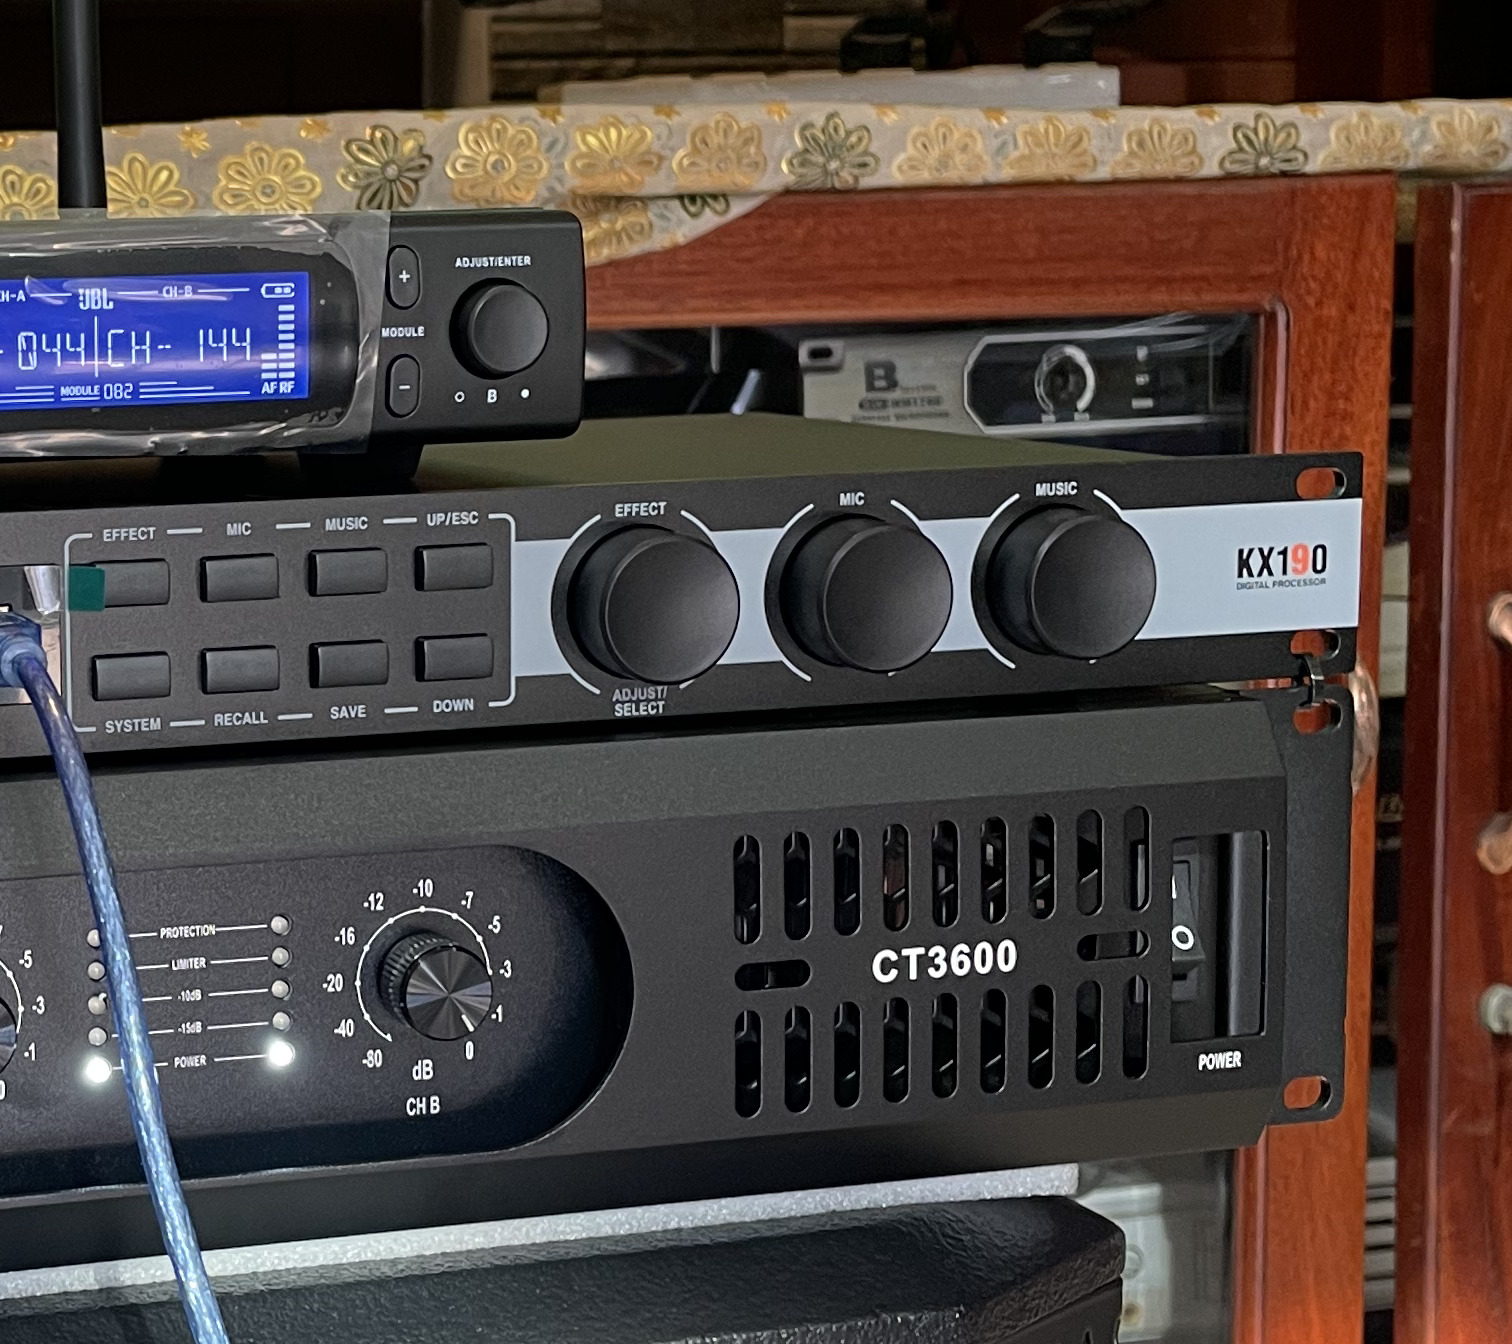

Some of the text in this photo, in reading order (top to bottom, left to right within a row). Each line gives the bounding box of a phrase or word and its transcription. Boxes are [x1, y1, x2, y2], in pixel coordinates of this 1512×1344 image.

[455, 256, 531, 268] ADJUST/ENTER
[79, 287, 113, 310] JBL
[162, 285, 193, 298] CH-B
[381, 326, 425, 338] MODULE
[60, 383, 134, 401] MODULE 082
[261, 381, 294, 395] AF RF
[487, 389, 497, 403] B
[1035, 481, 1078, 497] MUSIC
[839, 492, 865, 507] MIC
[614, 501, 667, 518] EFFECT
[325, 516, 368, 531] MUSIC
[426, 511, 479, 527] UP/ESC
[103, 527, 156, 542] EFFECT
[226, 522, 252, 537] MIC
[1237, 543, 1328, 578] KX190
[1236, 577, 1327, 591] DIGITAL PROCESSOR
[613, 686, 668, 702] ADJUST/
[330, 705, 367, 720] SAVE
[433, 699, 475, 714] DOWN
[614, 701, 665, 717] SELECT
[105, 717, 162, 734] SYSTEM
[214, 712, 268, 727] RECALL
[412, 879, 433, 898] -10
[363, 892, 384, 911] -12
[461, 891, 474, 909] -7
[159, 924, 216, 939] PROTECTION
[488, 915, 502, 934] -5
[334, 927, 356, 946] -16
[19, 950, 33, 969] -5
[171, 957, 206, 970] LIMITER
[872, 939, 1017, 984] CT3600
[499, 960, 512, 979] -3
[322, 973, 344, 993] -20
[32, 996, 45, 1015] -3
[491, 1004, 503, 1023] -1
[334, 1018, 355, 1038] -40
[24, 1043, 37, 1061] -1
[362, 1049, 383, 1068] -80
[465, 1041, 475, 1060] 0
[174, 1055, 207, 1068] POWER
[412, 1059, 434, 1080] dB
[1198, 1051, 1242, 1071] POWER
[406, 1095, 441, 1117] CH B
